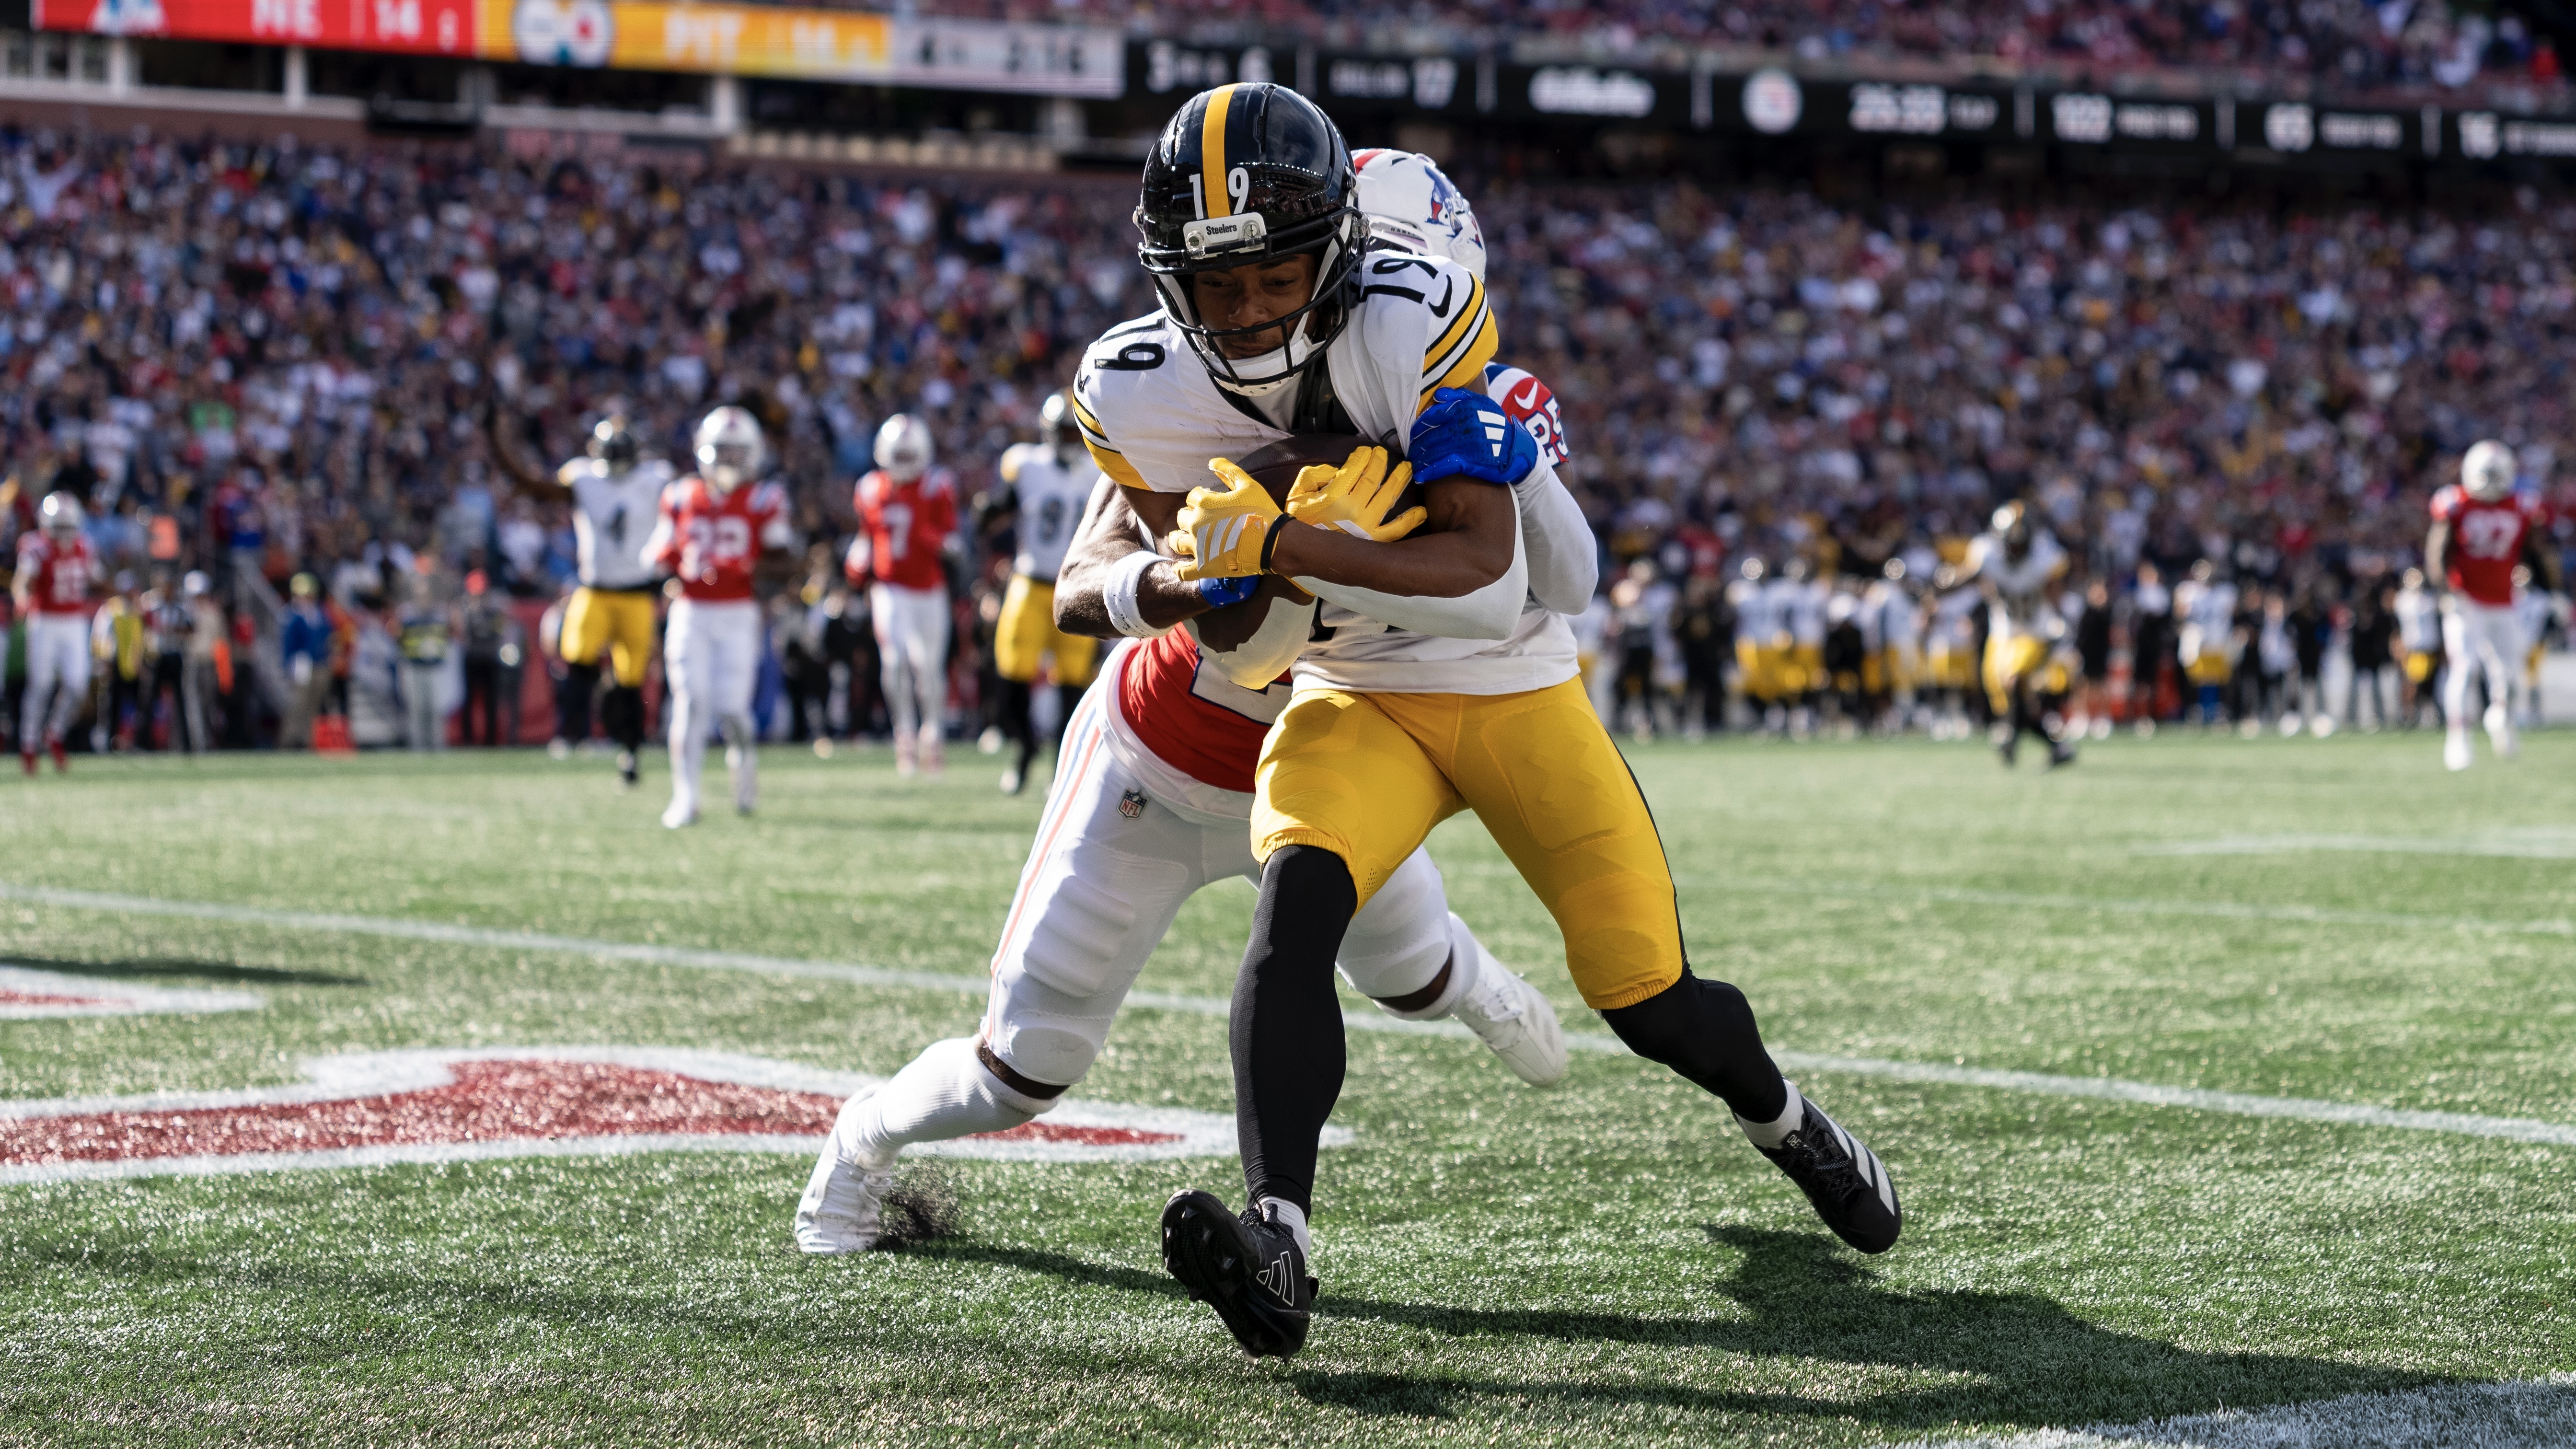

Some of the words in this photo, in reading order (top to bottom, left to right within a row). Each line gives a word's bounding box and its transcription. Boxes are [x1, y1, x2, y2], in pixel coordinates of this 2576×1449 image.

[1189, 167, 1249, 220] 19
[1206, 223, 1238, 236] Steelers
[1349, 257, 1439, 304] 19
[1094, 316, 1166, 371] 19
